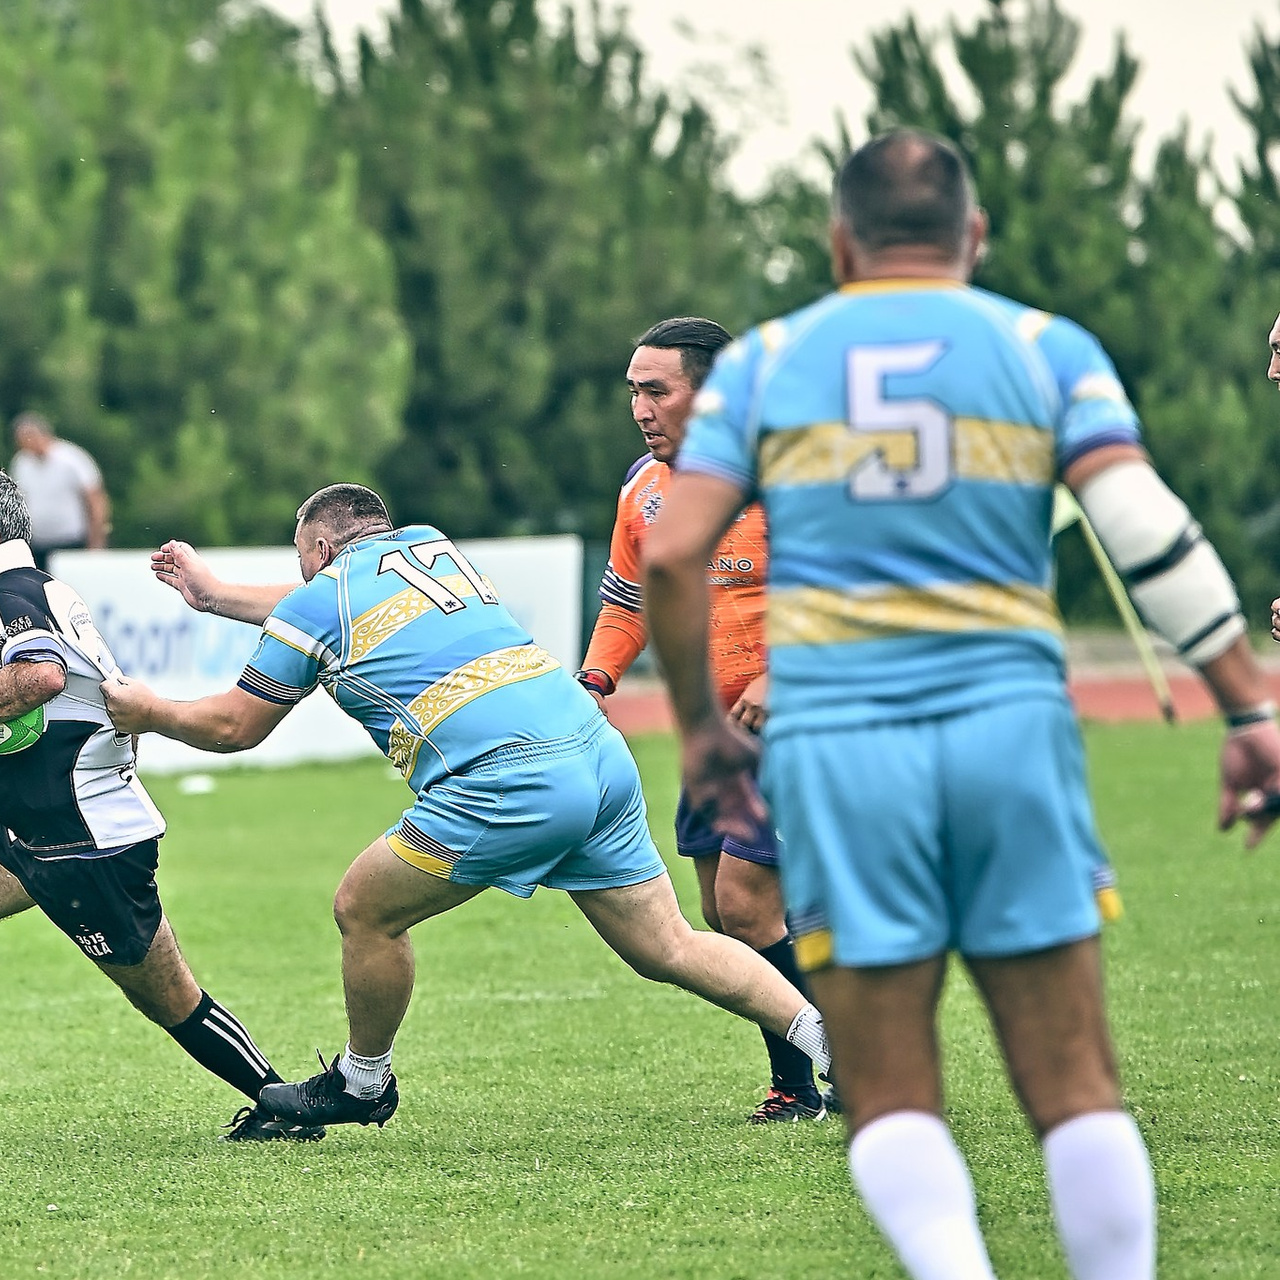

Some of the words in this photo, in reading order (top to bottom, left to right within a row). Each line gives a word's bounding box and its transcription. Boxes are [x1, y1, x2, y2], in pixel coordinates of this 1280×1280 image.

[843, 336, 956, 504] 5
[377, 538, 499, 615] 17
[706, 556, 754, 572] ANO
